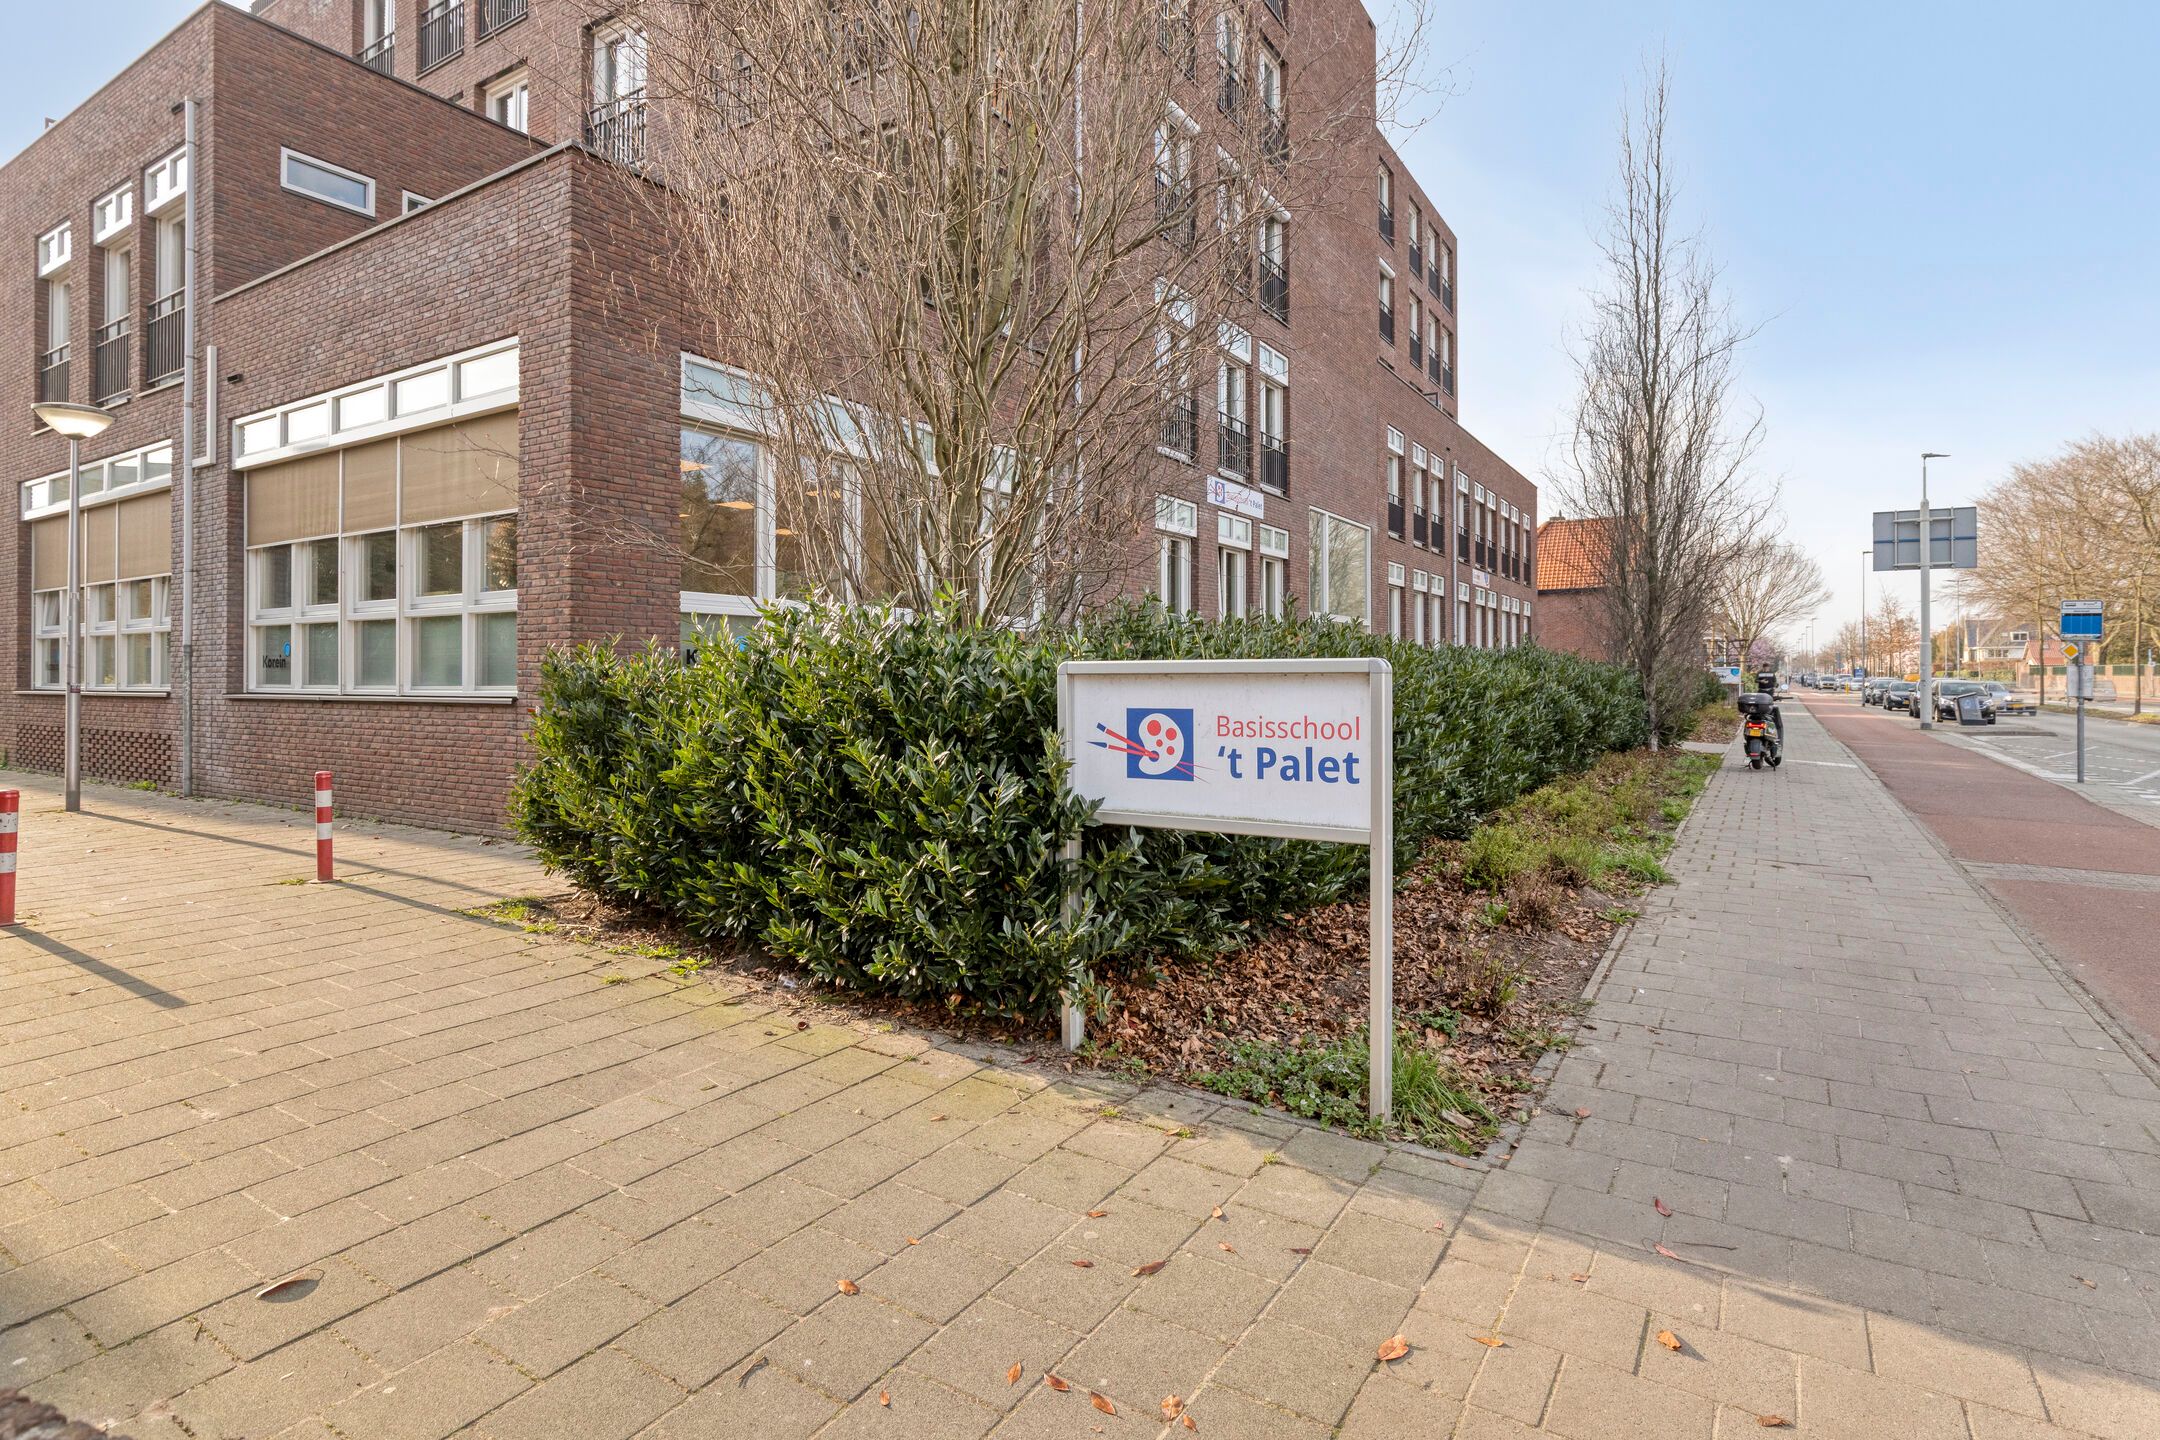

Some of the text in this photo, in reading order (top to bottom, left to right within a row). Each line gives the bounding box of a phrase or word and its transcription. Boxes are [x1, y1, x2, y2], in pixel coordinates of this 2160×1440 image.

[262, 655, 287, 669] Korein
[1217, 715, 1360, 741] Basisschool
[1257, 746, 1360, 784] Palet
